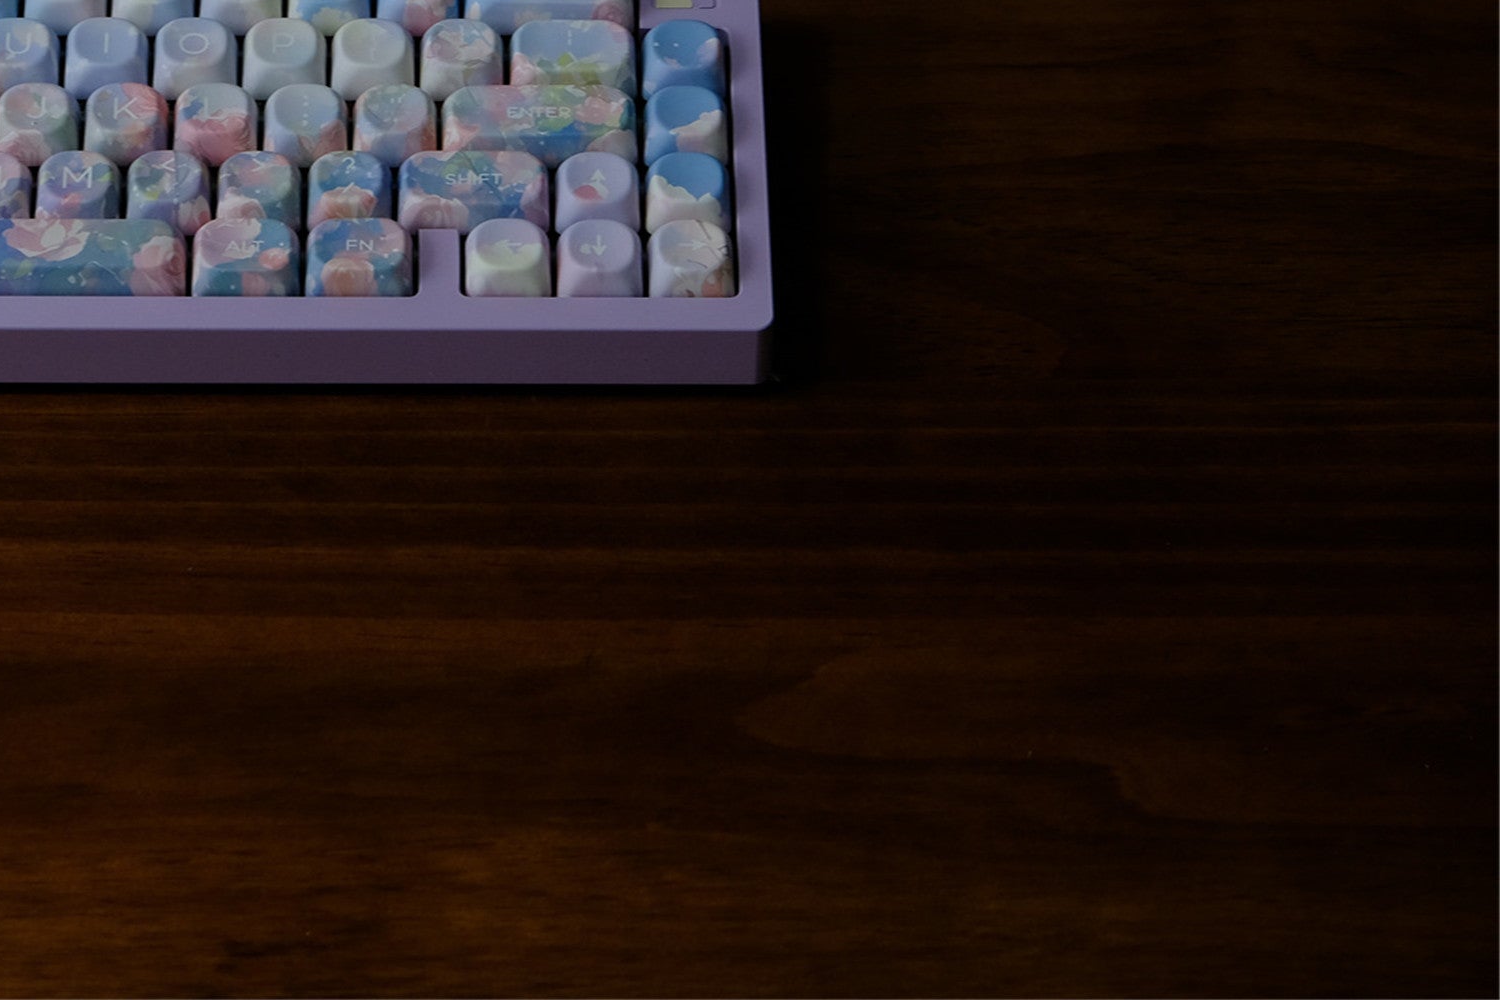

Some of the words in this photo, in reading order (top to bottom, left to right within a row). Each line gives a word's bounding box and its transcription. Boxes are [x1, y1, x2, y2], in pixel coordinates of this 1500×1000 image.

[5, 32, 32, 55] U
[179, 32, 210, 55] O
[272, 32, 294, 54] P
[26, 96, 47, 119] J
[113, 96, 139, 120] K
[204, 96, 224, 120] L
[507, 107, 571, 119] ENTER
[342, 156, 355, 174] ?
[62, 166, 92, 189] M
[445, 171, 503, 186] SHIFT
[225, 239, 265, 253] ALT
[346, 239, 375, 252] FN
